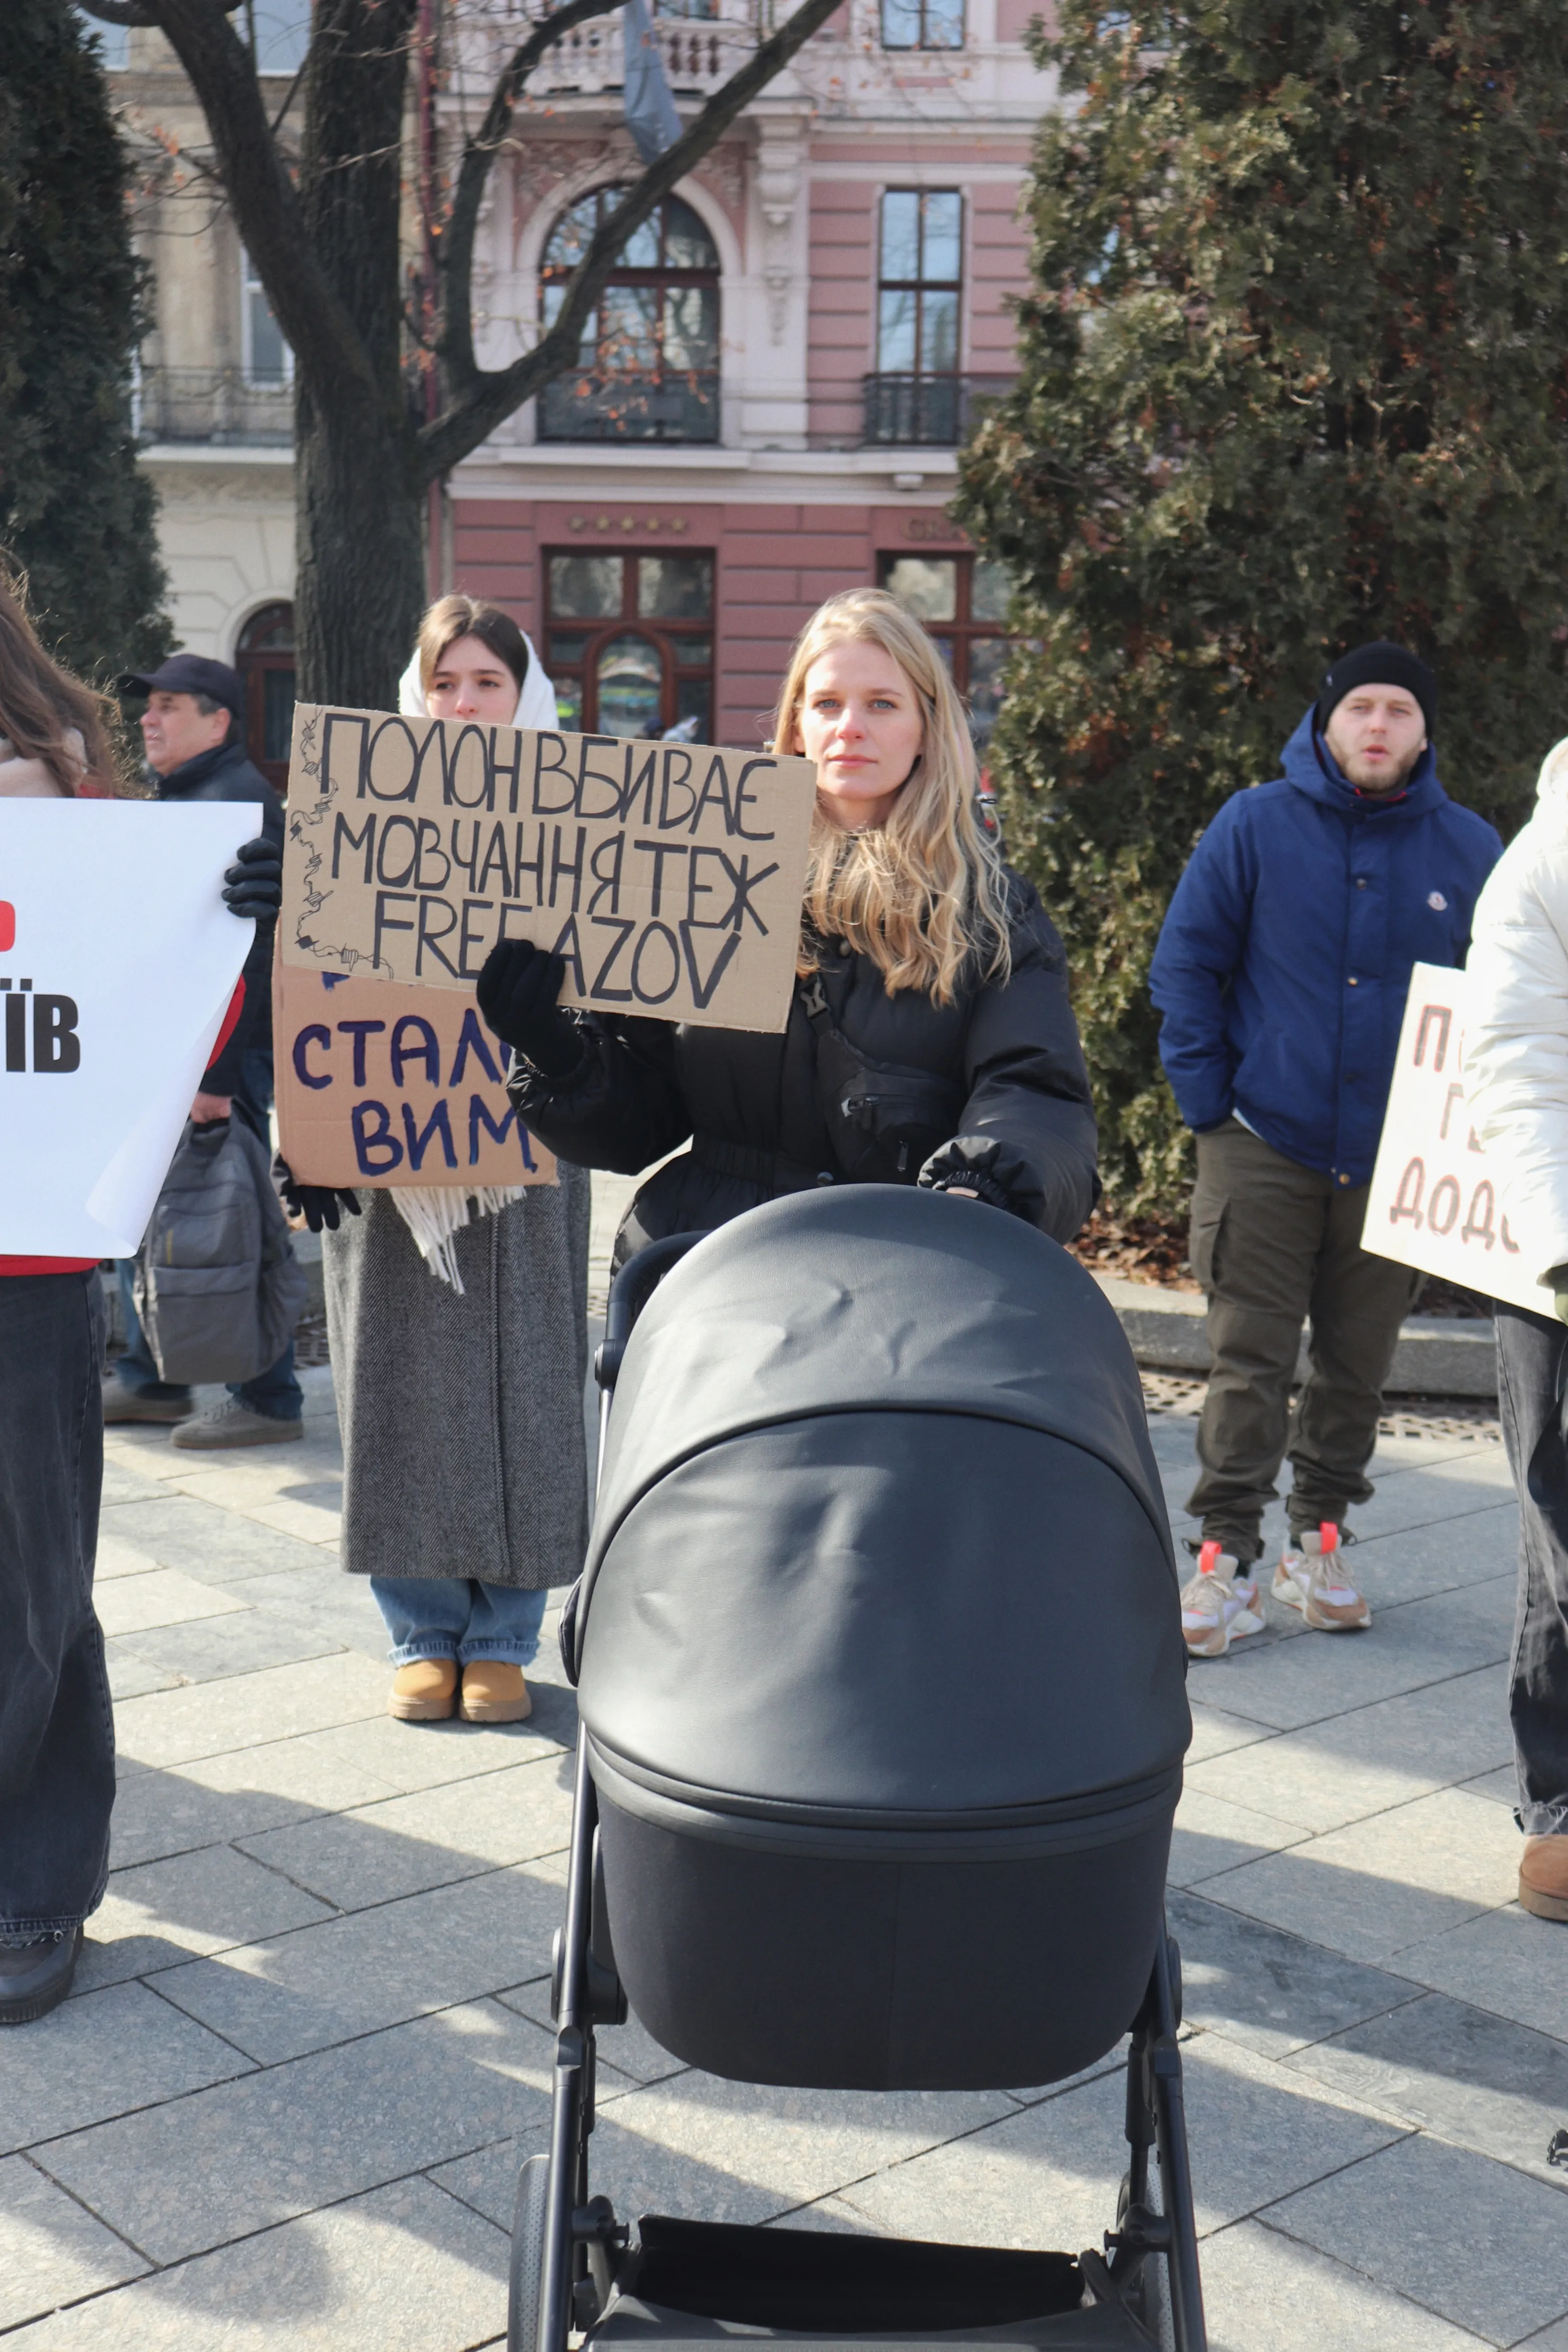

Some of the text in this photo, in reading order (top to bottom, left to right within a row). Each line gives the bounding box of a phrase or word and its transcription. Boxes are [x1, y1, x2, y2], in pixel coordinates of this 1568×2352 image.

[320, 713, 777, 840] ПОЛОН ВБИВАЄ
[331, 812, 780, 936] МОВЧАННЯ ТЕЖ
[549, 912, 742, 1010] AZOV
[292, 1008, 510, 1090] СТАЛ
